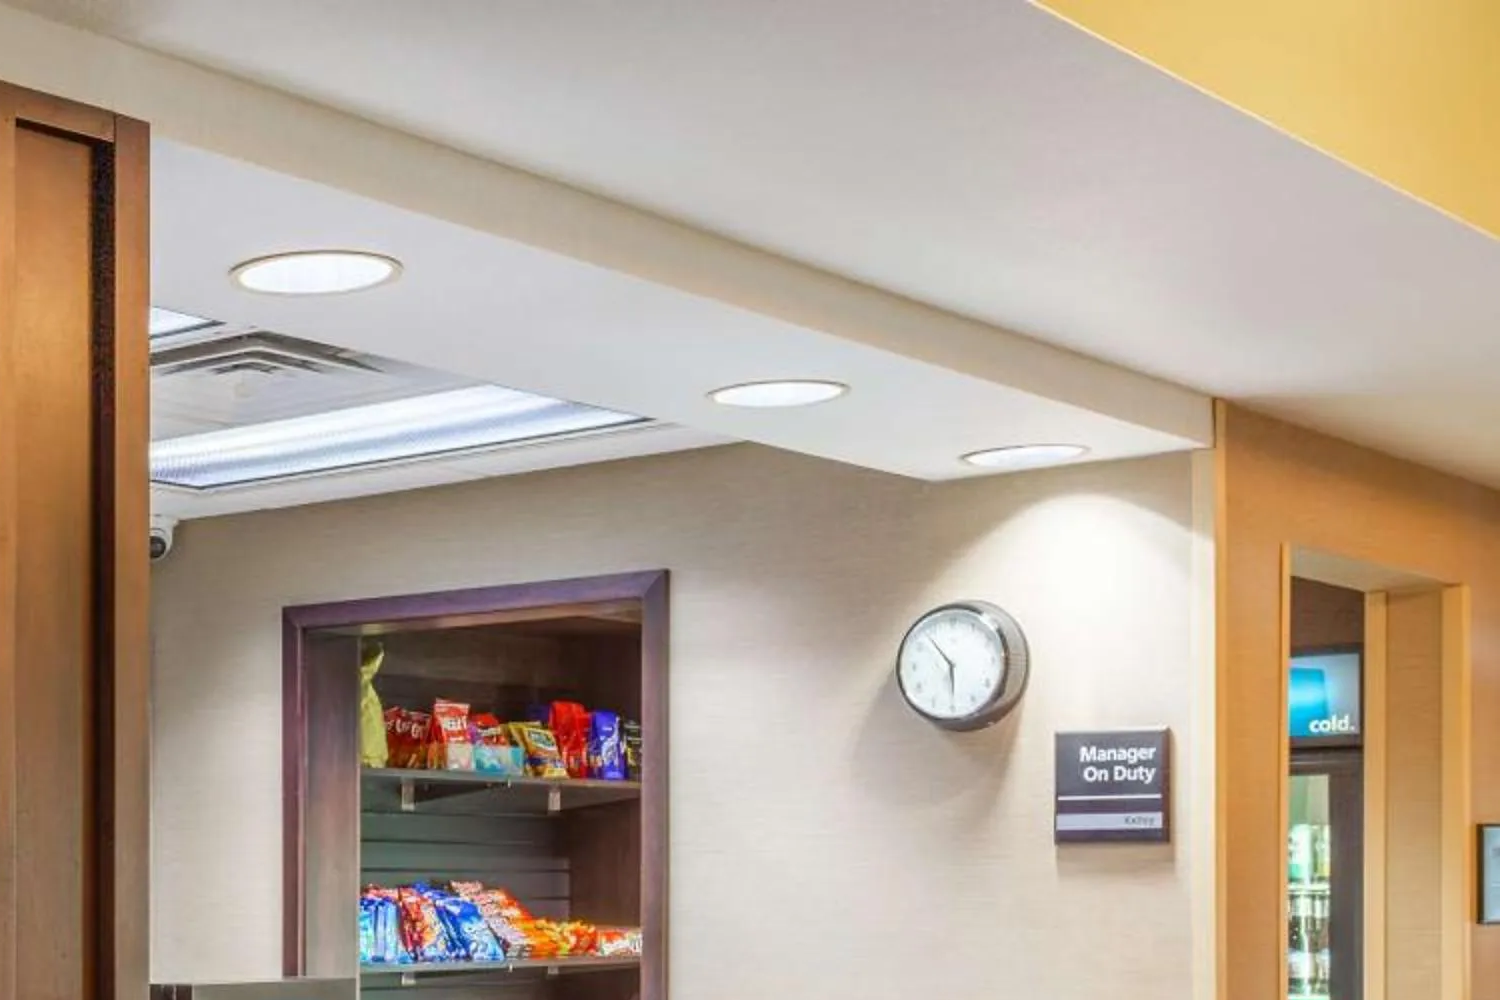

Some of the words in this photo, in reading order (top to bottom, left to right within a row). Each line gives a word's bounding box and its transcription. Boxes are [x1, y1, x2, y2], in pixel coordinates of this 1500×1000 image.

[1308, 714, 1356, 733] cold.
[1079, 745, 1157, 764] Manager
[1083, 765, 1109, 783] On
[1113, 765, 1157, 785] Duty
